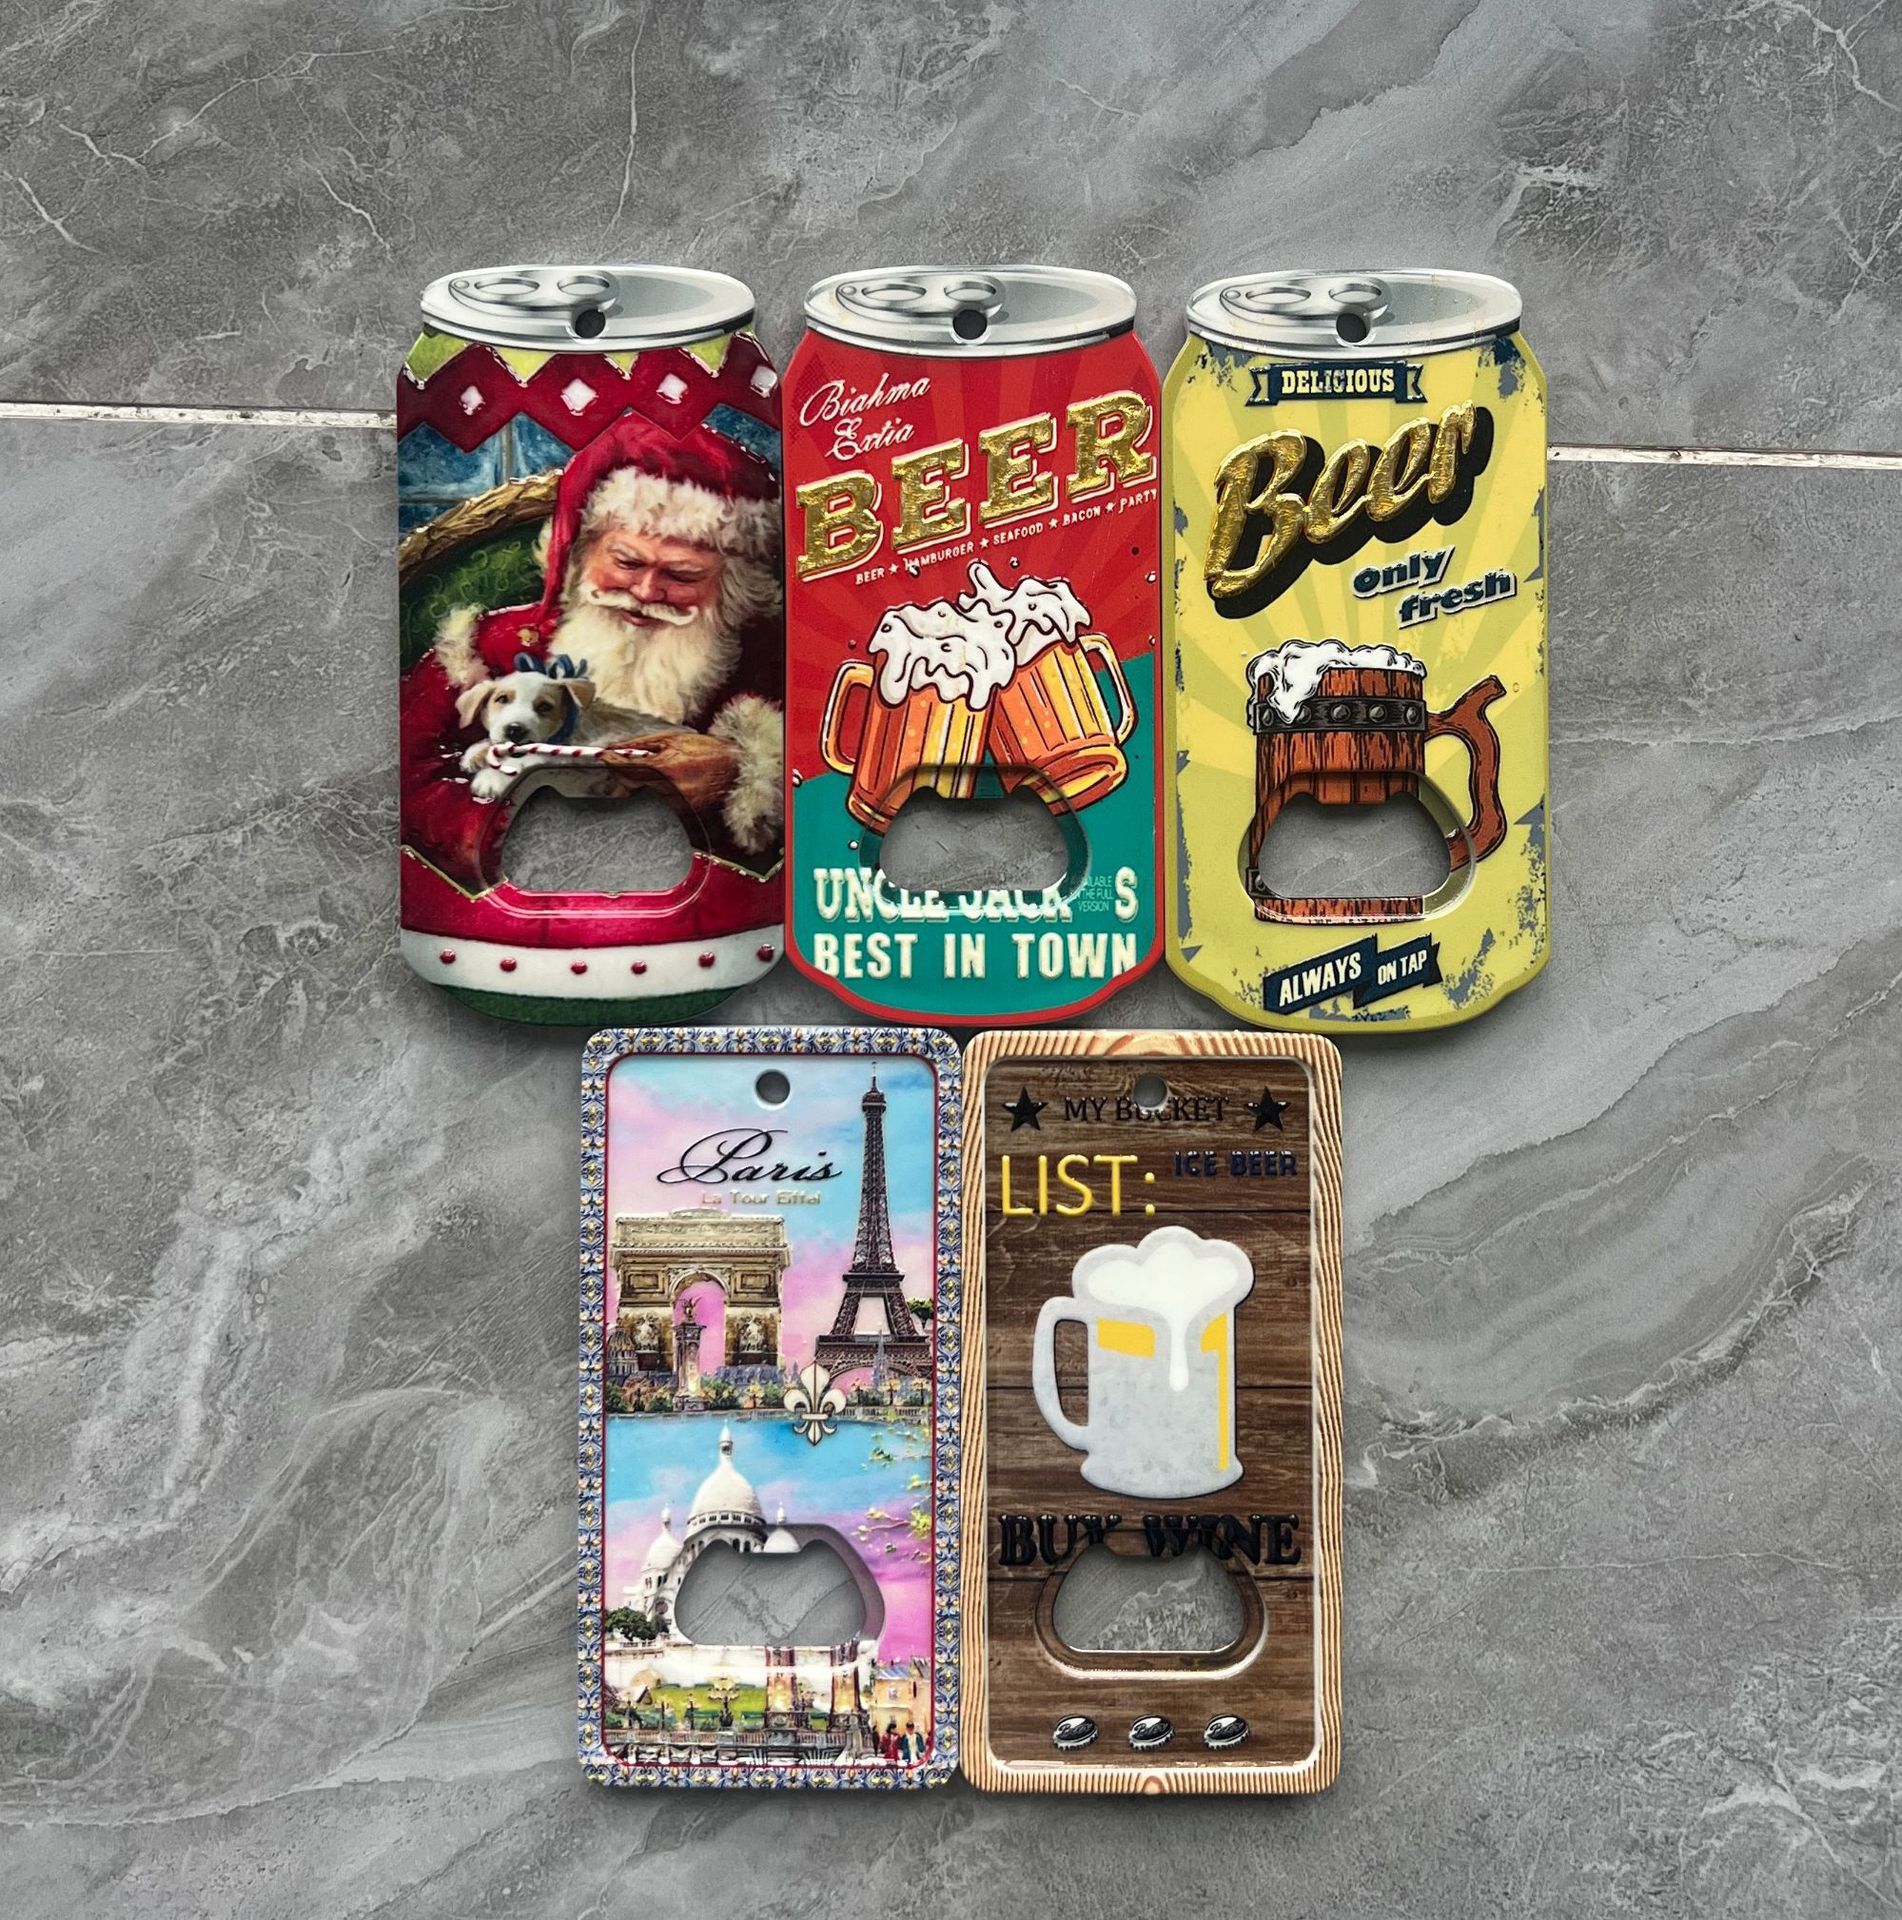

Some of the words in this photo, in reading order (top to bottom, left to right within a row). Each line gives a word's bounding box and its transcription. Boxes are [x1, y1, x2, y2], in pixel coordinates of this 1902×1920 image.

[1281, 369, 1394, 394] DELICIOUS
[795, 390, 1157, 582] BEER
[1204, 400, 1478, 598] Beer
[855, 566, 885, 585] BEER
[903, 541, 974, 570] HAMBURGER
[993, 522, 1043, 545] SEAFOOD
[1062, 506, 1100, 527] BACON
[1118, 489, 1157, 513] PARTY
[1354, 548, 1452, 598] only
[1399, 571, 1514, 627] fresh
[814, 933, 918, 979] BEST
[944, 933, 985, 979] IN
[1012, 933, 1136, 979] TOWN
[1279, 951, 1361, 1007] ALWAYS
[1378, 963, 1397, 985] ON
[1400, 950, 1428, 976] TAP
[1065, 1096, 1107, 1121] MY
[657, 1128, 842, 1184] Paris
[1002, 1154, 1155, 1216] LIST:
[1175, 1150, 1217, 1177] ICE
[1230, 1150, 1297, 1177] BEER
[701, 1190, 721, 1204] La
[730, 1190, 769, 1204] Tour
[998, 1513, 1122, 1565] BUY
